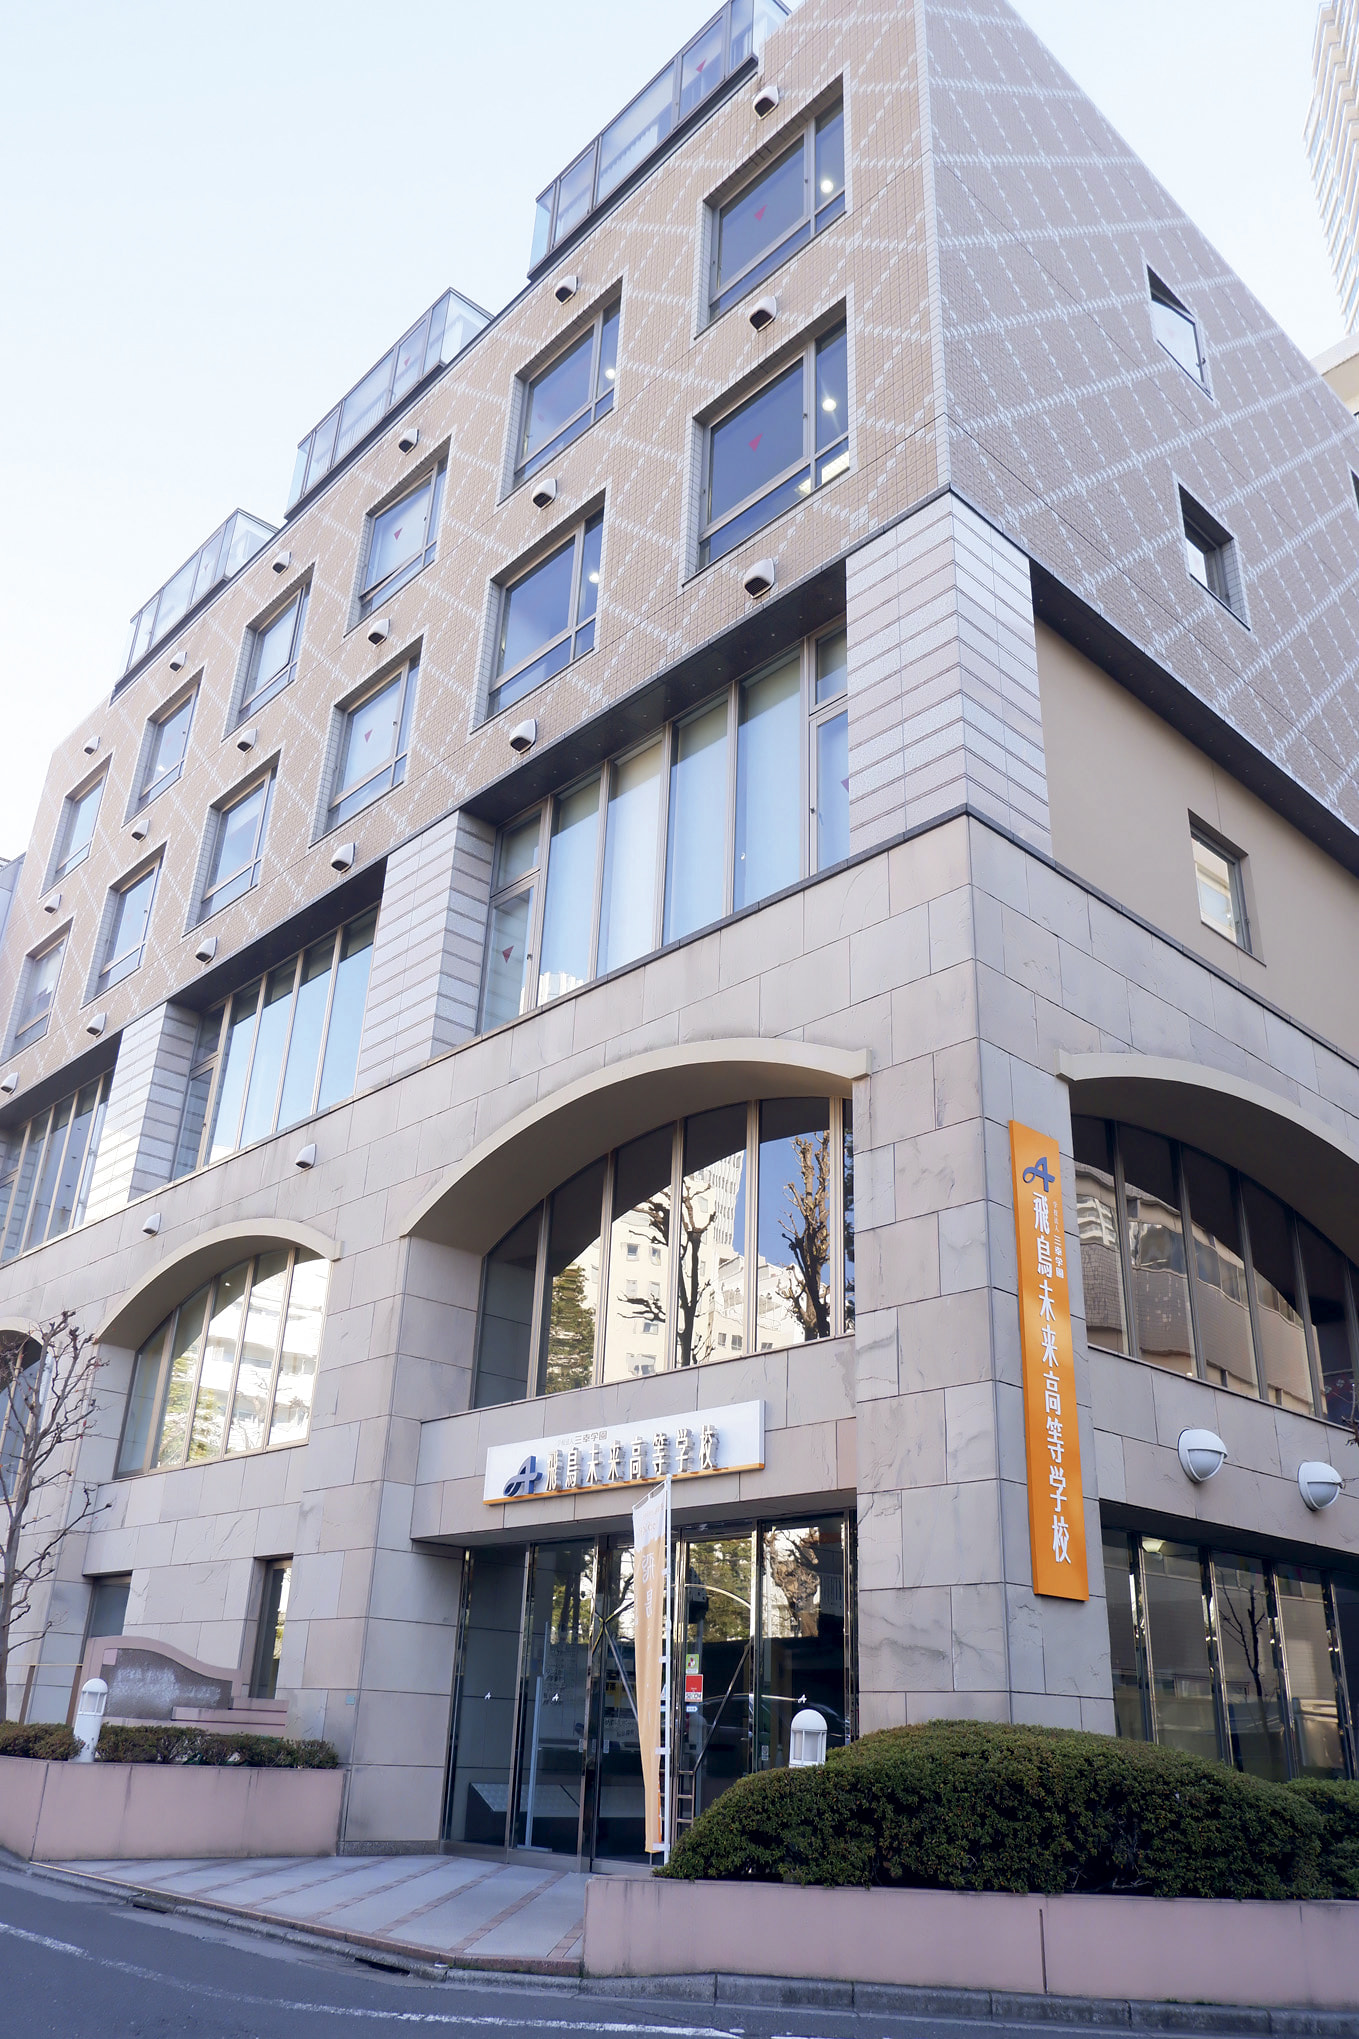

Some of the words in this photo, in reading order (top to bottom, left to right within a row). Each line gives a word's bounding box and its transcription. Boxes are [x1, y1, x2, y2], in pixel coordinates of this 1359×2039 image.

[545, 1424, 719, 1491] 飛鳥未来高等学校
[1032, 1191, 1072, 1564] 飛鳥未来高等学校
